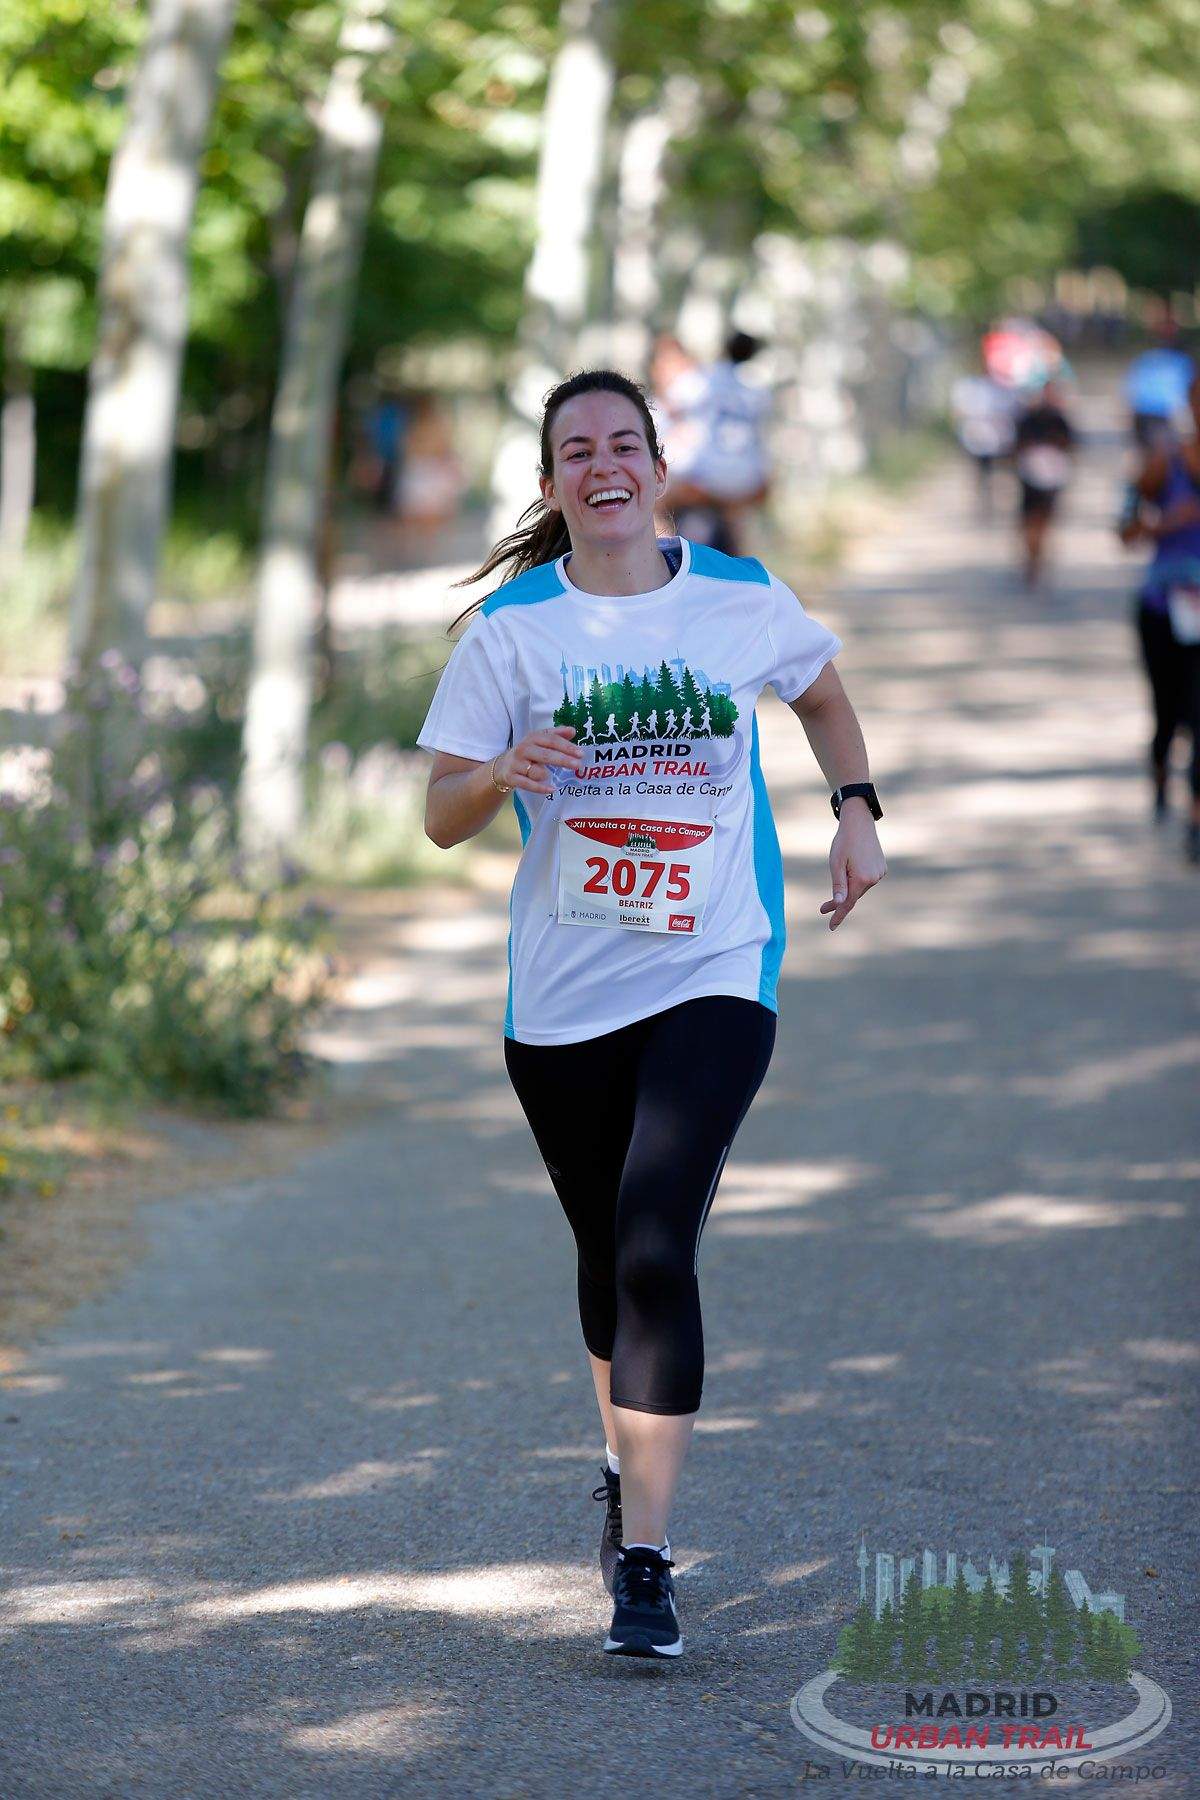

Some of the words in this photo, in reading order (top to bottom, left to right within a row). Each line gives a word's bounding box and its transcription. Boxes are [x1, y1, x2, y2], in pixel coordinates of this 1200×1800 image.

[594, 744, 691, 763] MADRID
[575, 762, 647, 780] URBAN
[653, 761, 710, 776] TRAIL
[559, 784, 601, 798] Vuelta
[605, 787, 614, 796] a
[618, 783, 631, 796] la
[636, 782, 671, 795] Casa
[677, 783, 695, 795] de
[574, 821, 586, 829] XII
[588, 821, 618, 829] Vuelta
[628, 822, 637, 831] la
[640, 823, 663, 833] Casa
[664, 825, 677, 834] de
[678, 827, 706, 838] Campo
[583, 856, 691, 901] 2075
[618, 899, 654, 910] BEATRIZ
[579, 912, 607, 921] MADRID
[619, 914, 650, 925] Iberext
